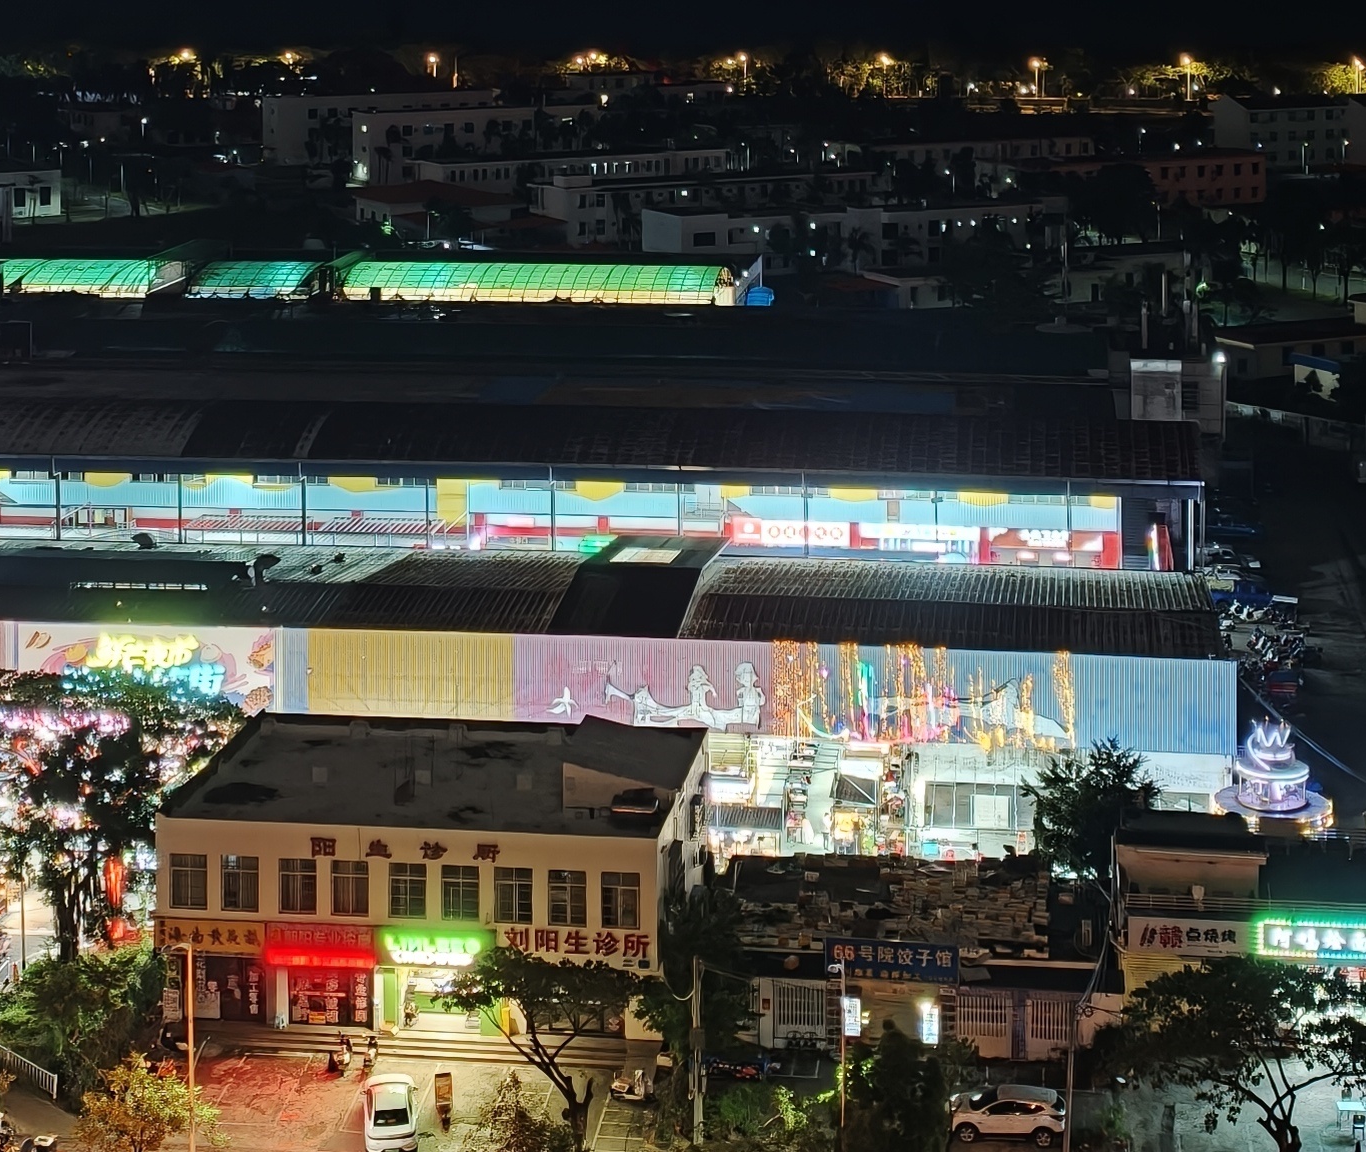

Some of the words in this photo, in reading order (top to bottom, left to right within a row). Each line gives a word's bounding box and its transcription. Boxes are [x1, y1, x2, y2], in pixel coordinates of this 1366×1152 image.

[310, 837, 500, 863] 阳生诊所
[504, 927, 651, 957] 刘阳生诊所
[833, 944, 953, 968] 66号院饺子馆
